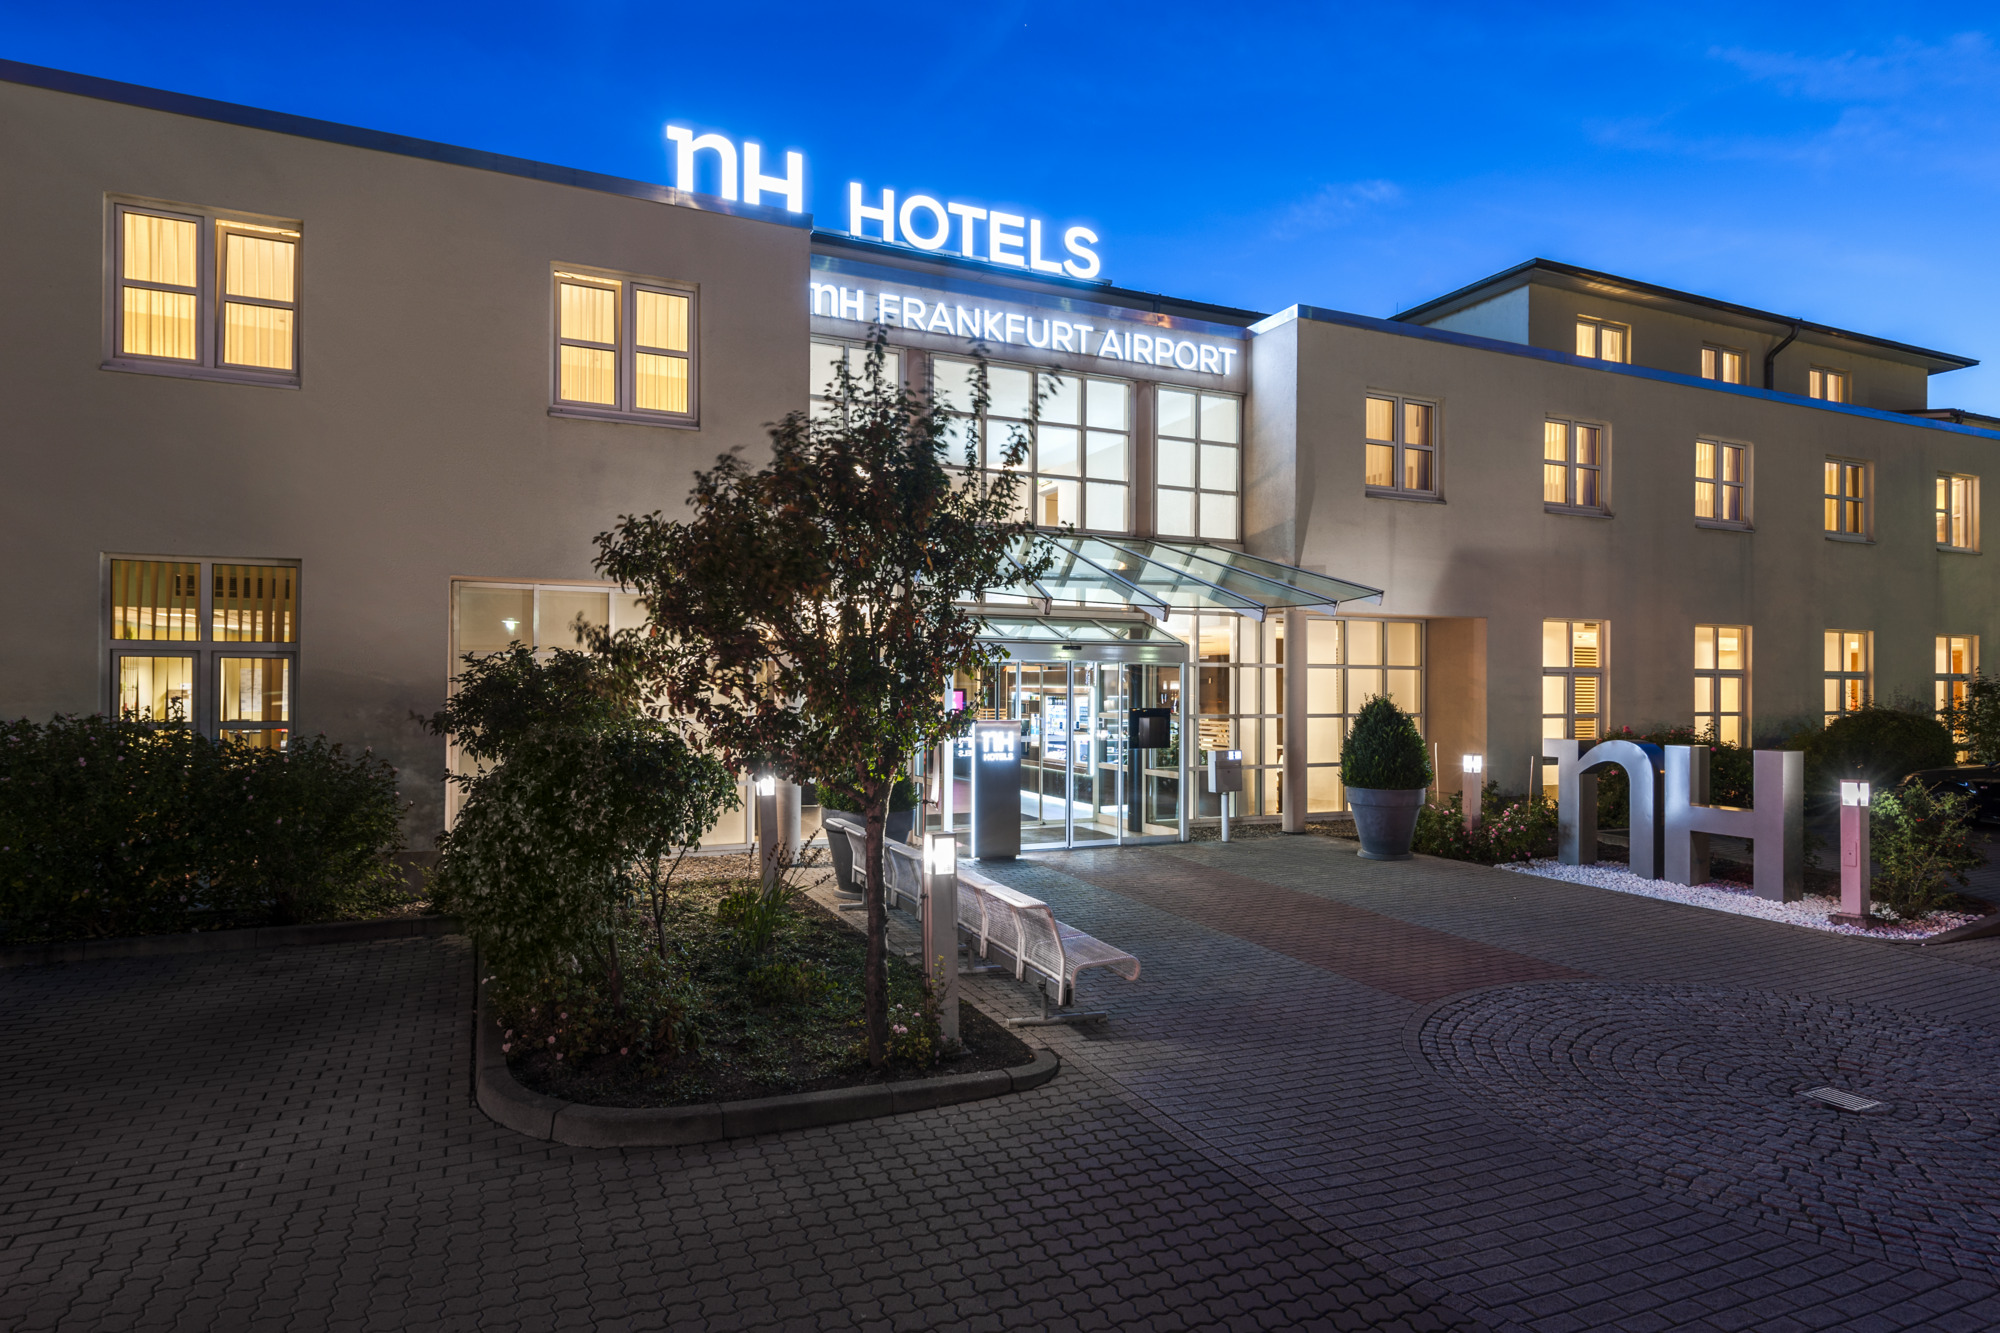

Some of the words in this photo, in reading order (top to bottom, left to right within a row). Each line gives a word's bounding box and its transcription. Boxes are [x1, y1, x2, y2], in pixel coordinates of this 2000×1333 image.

[849, 182, 1100, 279] HOTELS
[879, 293, 1094, 354] FRANKFURT
[1098, 329, 1237, 376] AIRPORT
[983, 752, 1014, 762] HOTELS
